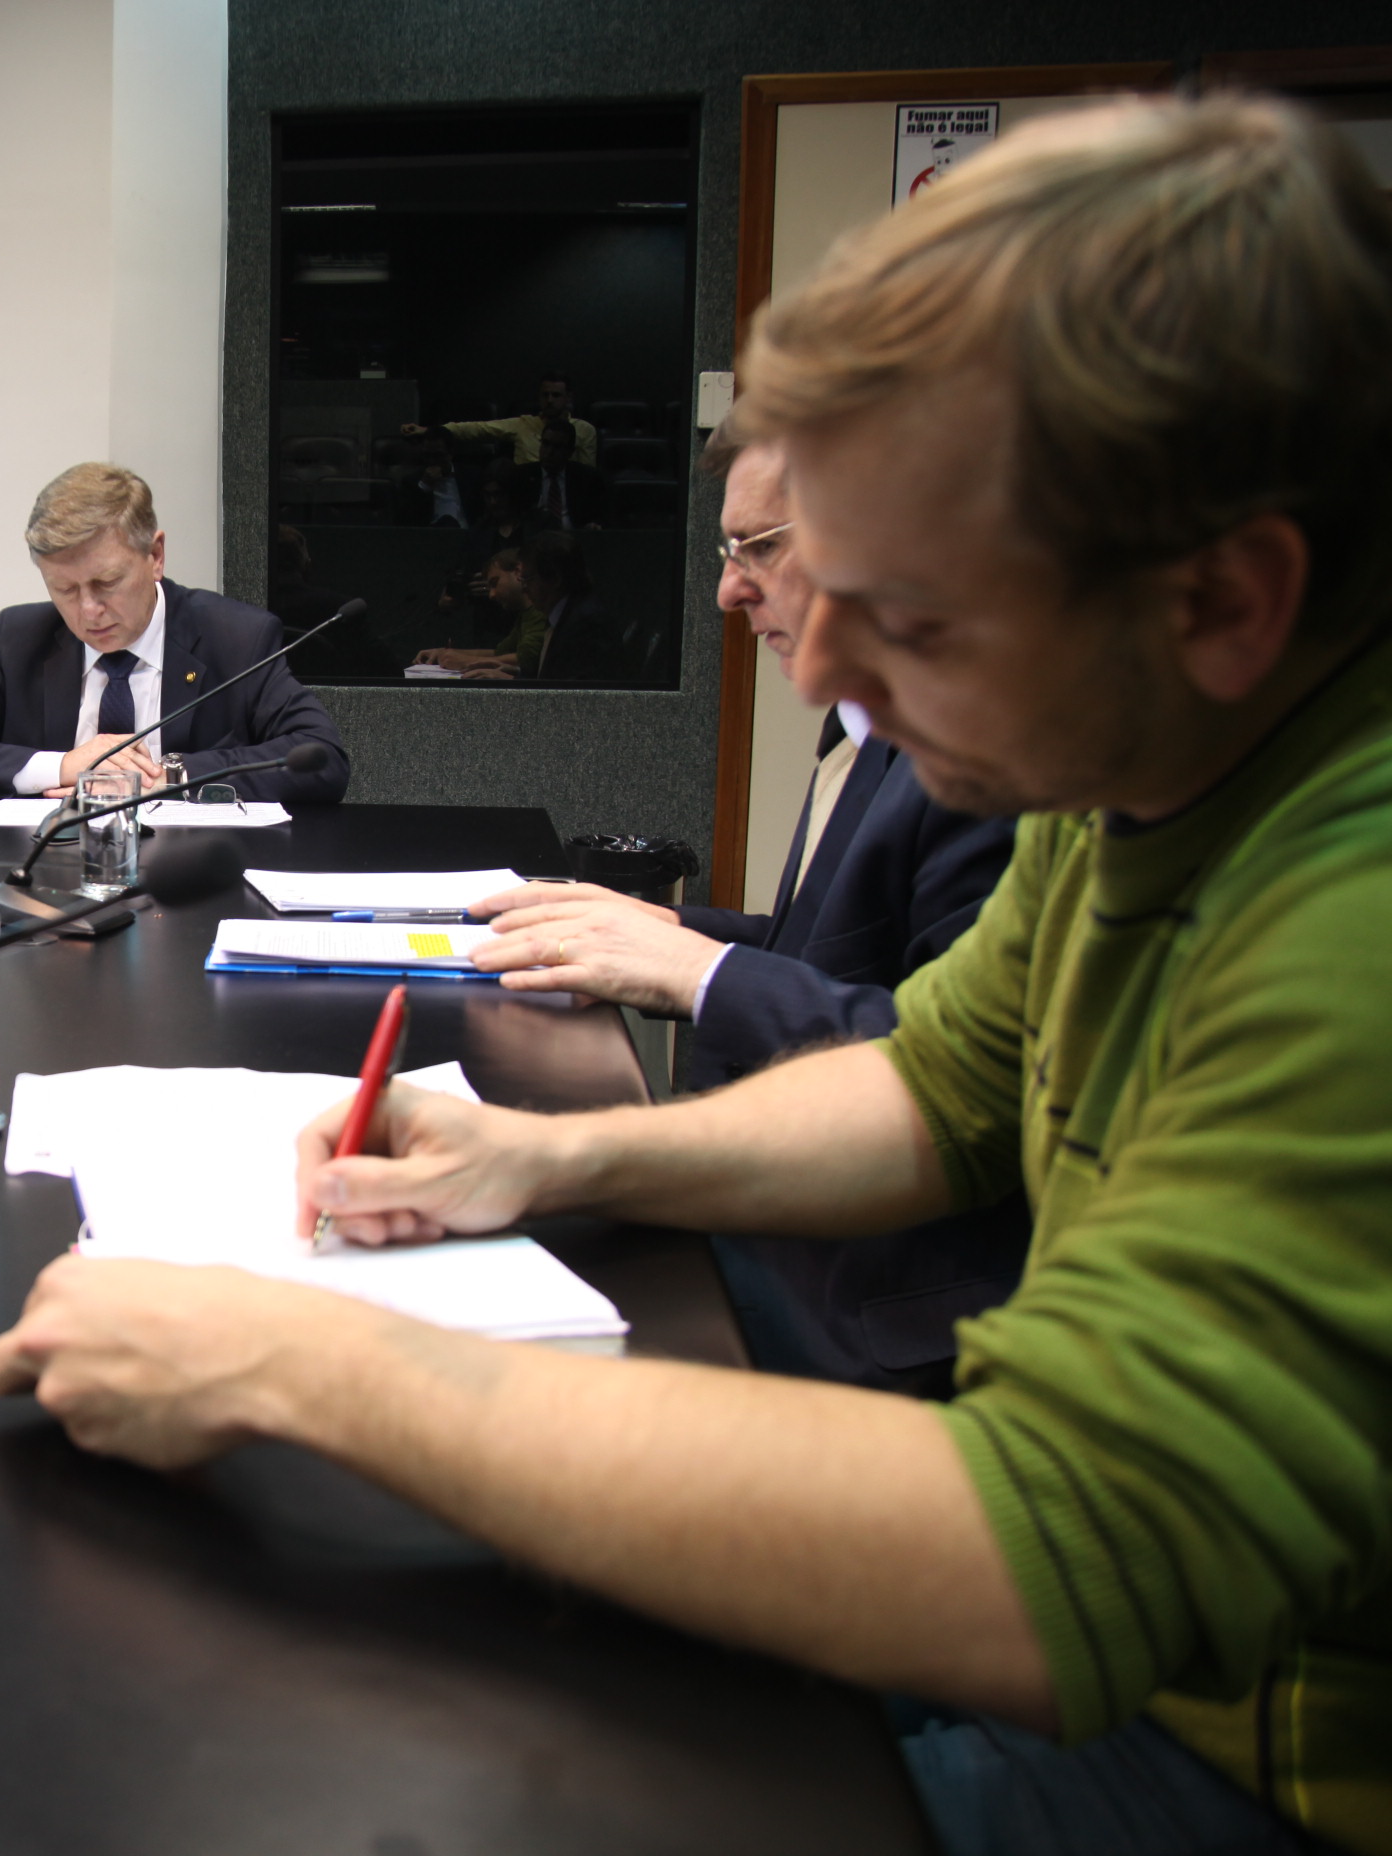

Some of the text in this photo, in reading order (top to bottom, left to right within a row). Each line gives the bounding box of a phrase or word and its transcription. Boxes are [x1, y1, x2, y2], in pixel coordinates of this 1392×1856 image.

[907, 109, 990, 122] Fumar aqui
[906, 121, 989, 134] não é legal
